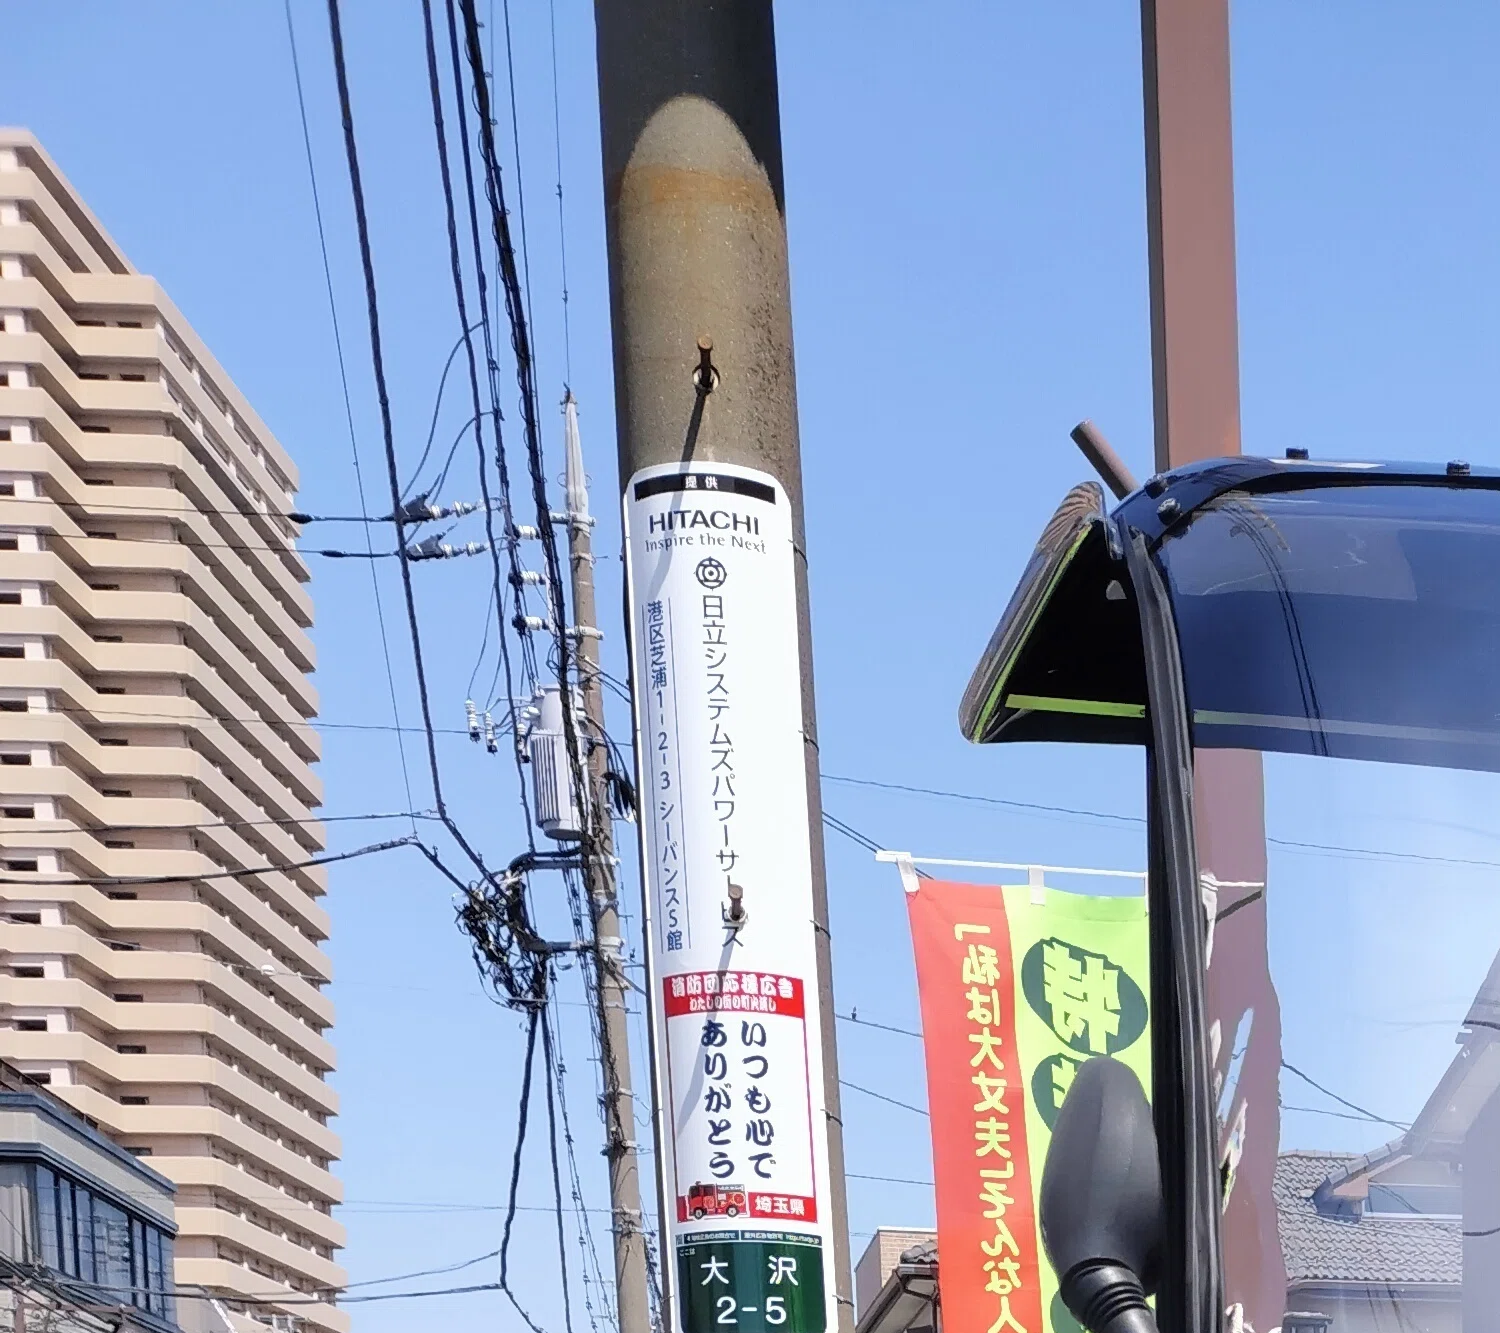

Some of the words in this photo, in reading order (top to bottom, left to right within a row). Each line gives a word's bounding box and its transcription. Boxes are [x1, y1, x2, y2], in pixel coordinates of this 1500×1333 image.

[685, 475, 718, 490] 提供
[649, 510, 759, 535] HITACHI
[645, 533, 694, 553] Inspire
[699, 533, 726, 547] the
[731, 535, 767, 554] Next
[701, 1019, 735, 1179] ありがとう
[755, 1195, 805, 1217] 埼玉県
[700, 1255, 799, 1287] 大沢
[716, 1296, 788, 1325] 2-5
